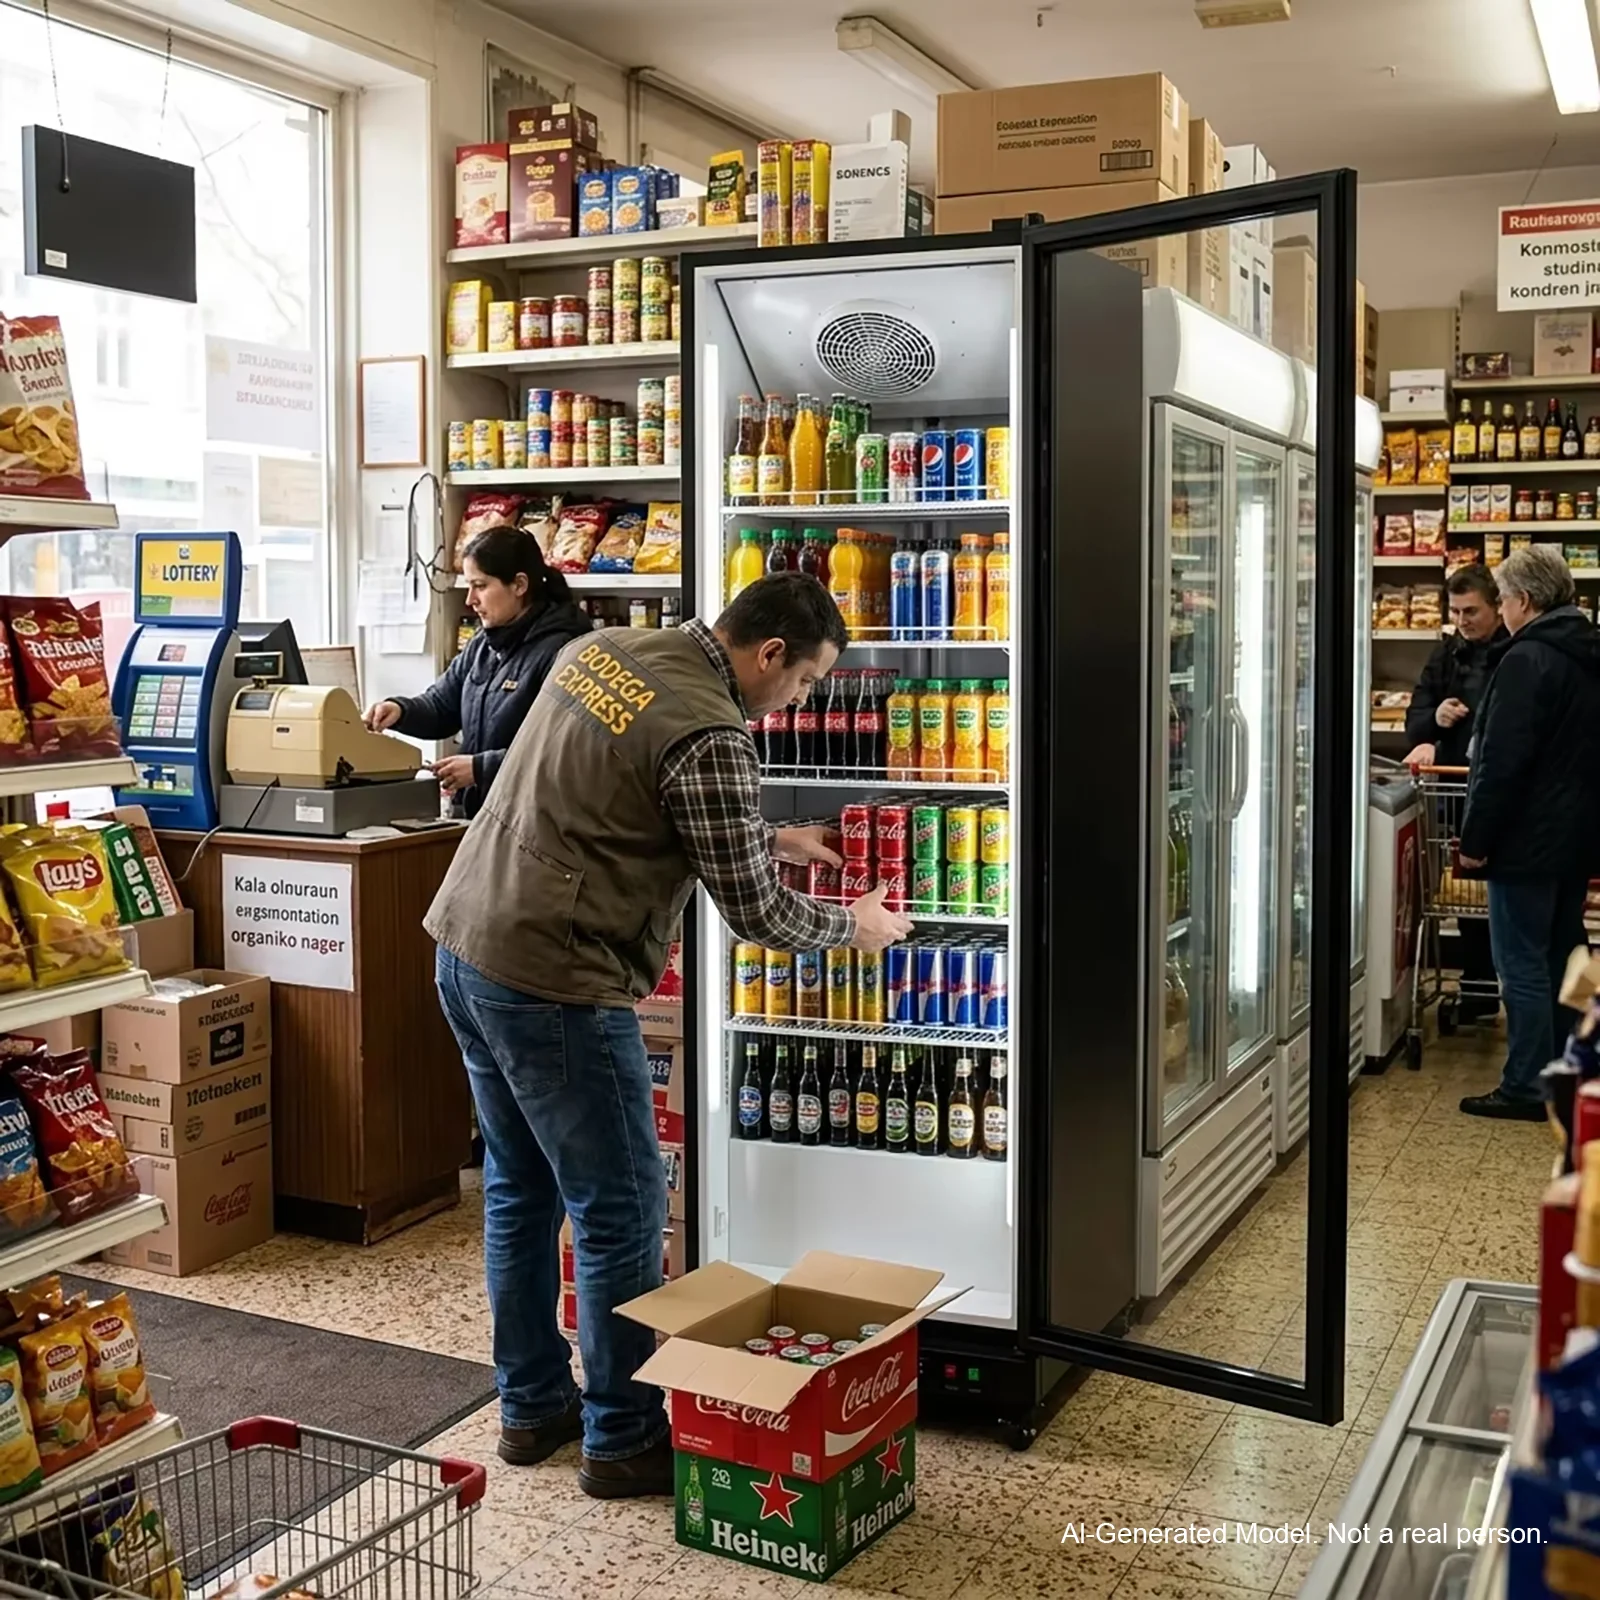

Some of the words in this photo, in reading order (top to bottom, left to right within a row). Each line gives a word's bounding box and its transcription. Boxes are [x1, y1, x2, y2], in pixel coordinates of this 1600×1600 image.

[163, 564, 219, 581] LOTTERY
[577, 644, 656, 712] BODEGA
[554, 663, 634, 735] EXPRESS
[40, 857, 98, 892] Lay's
[235, 876, 266, 893] Kala
[231, 930, 297, 947] organiko
[301, 937, 345, 955] nager
